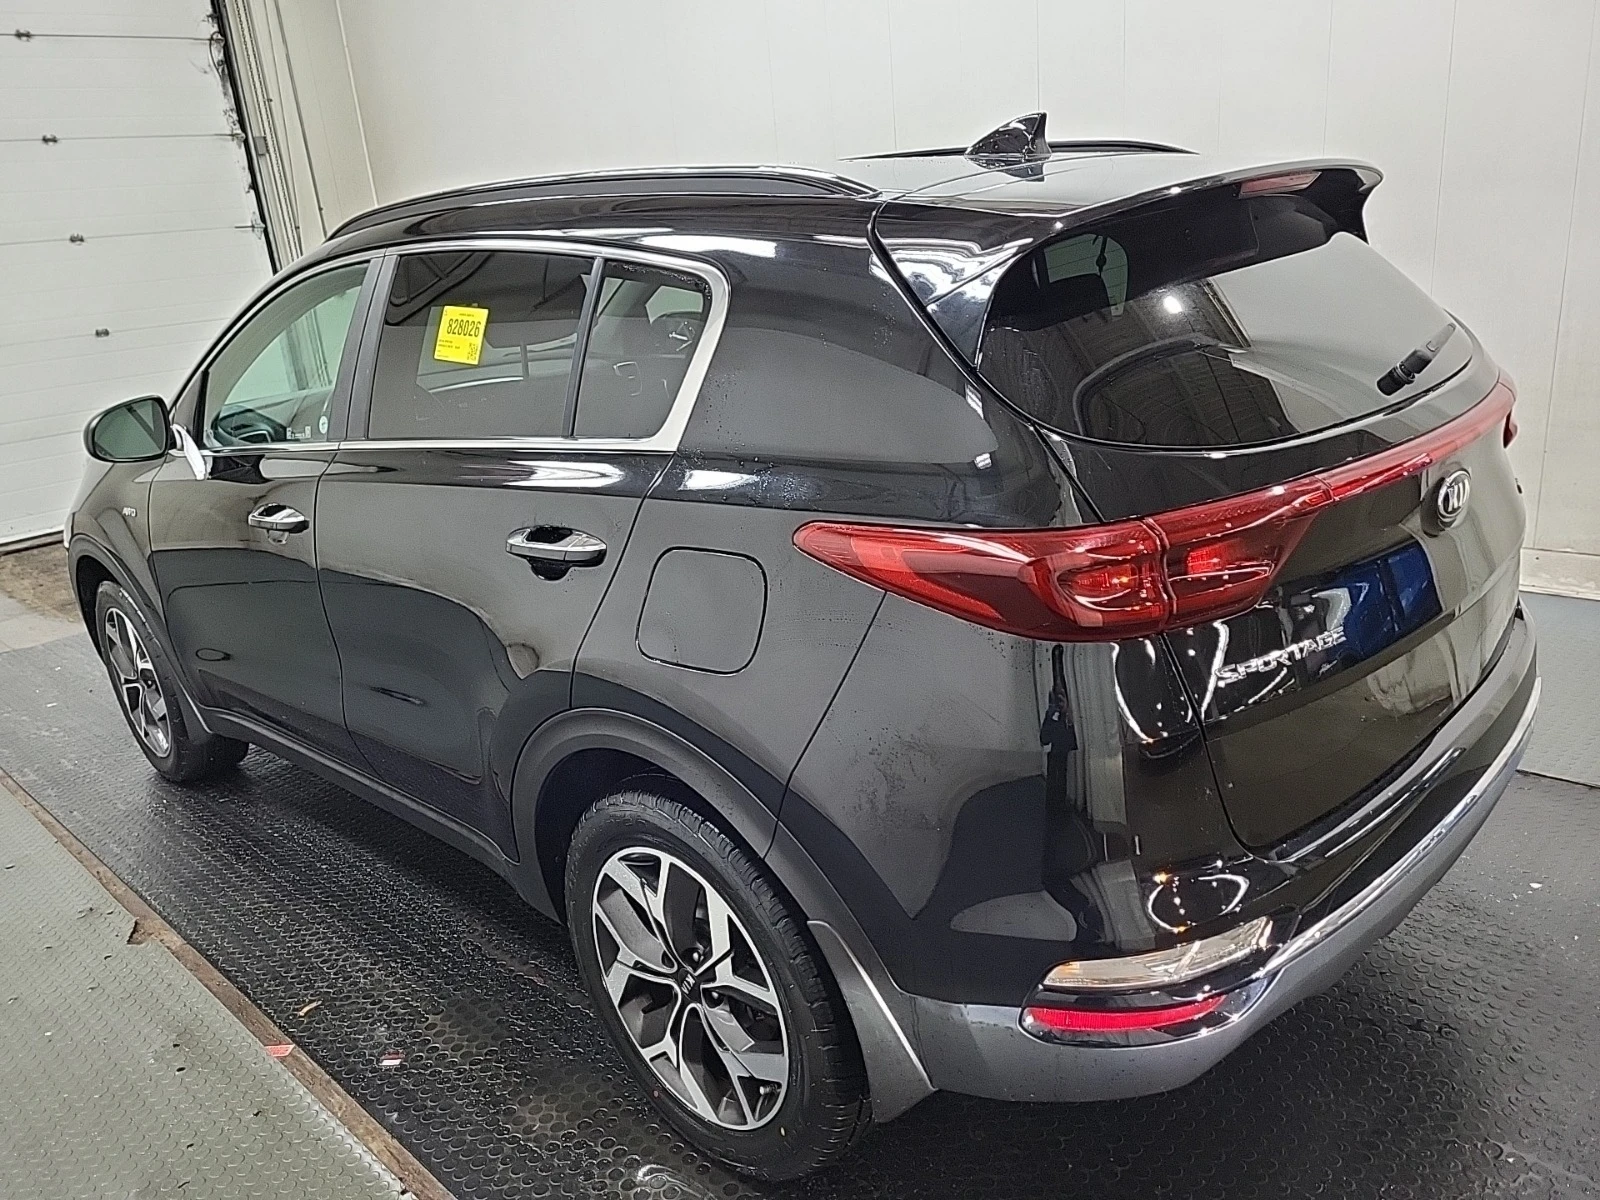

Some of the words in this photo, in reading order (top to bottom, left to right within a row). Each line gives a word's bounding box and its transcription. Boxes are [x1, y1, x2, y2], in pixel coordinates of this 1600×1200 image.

[446, 318, 482, 338] 828026
[1214, 626, 1347, 684] SPORTAGE
[680, 973, 696, 995] KIA
